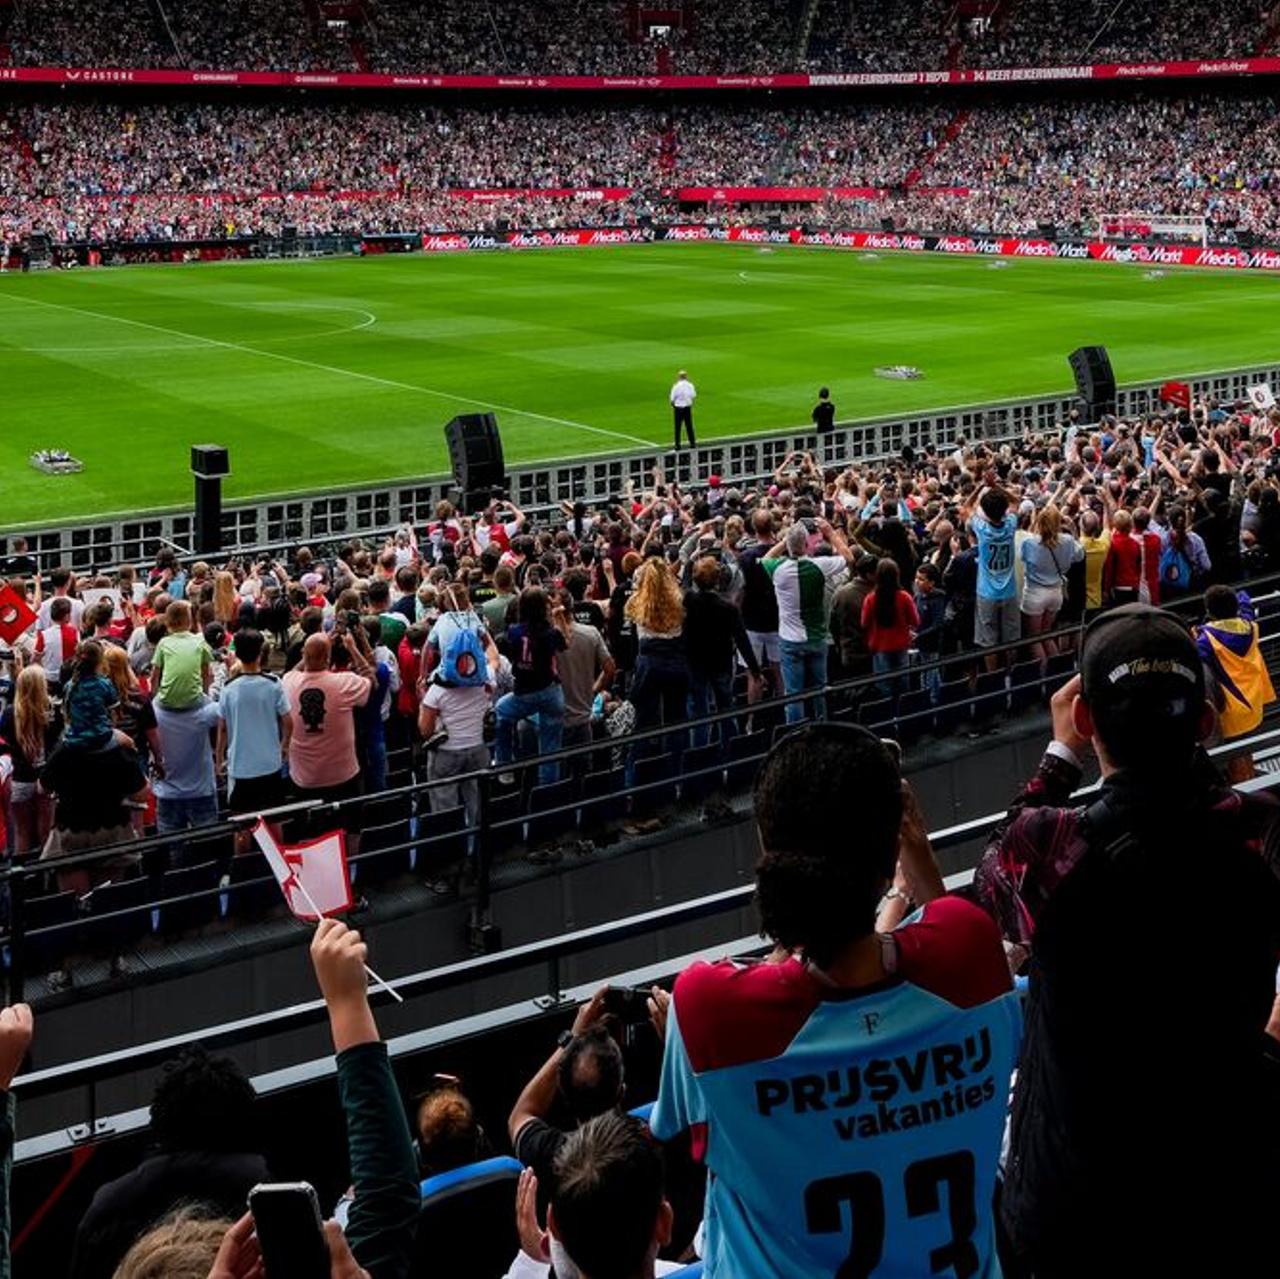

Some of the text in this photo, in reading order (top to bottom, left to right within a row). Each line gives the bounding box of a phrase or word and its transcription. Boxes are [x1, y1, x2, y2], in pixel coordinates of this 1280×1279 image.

[83, 71, 133, 80] CASTORE
[985, 69, 1011, 81] KEER
[935, 235, 966, 252] Media
[1014, 239, 1050, 256] Media
[1149, 248, 1183, 262] Markt
[1195, 250, 1238, 266] Media
[863, 1012, 880, 1036] F
[832, 1076, 995, 1140] vakanties
[804, 1150, 978, 1279] 23
